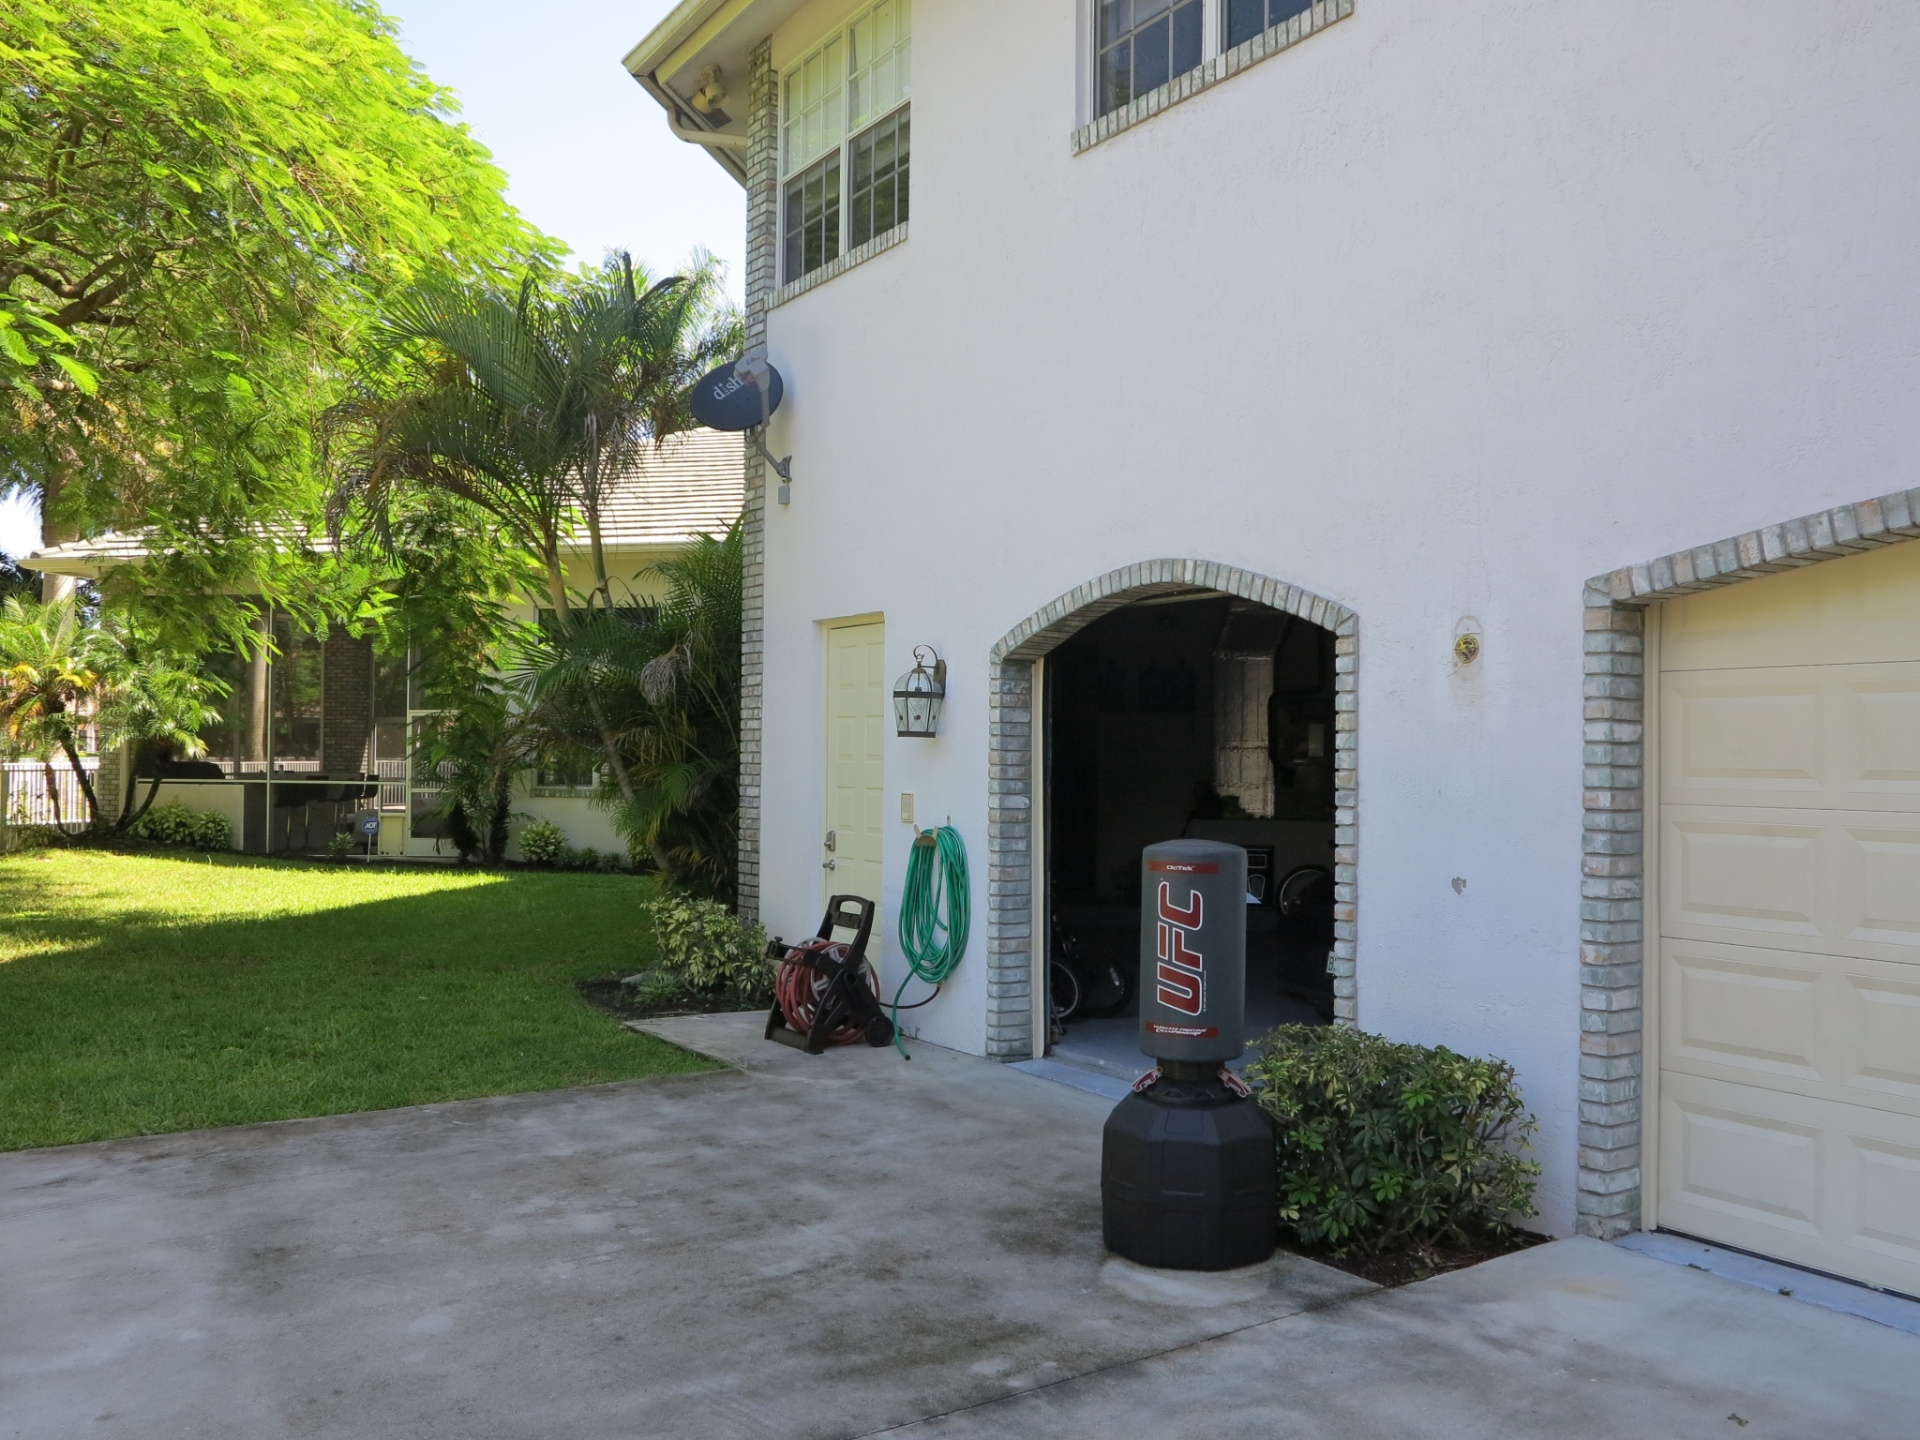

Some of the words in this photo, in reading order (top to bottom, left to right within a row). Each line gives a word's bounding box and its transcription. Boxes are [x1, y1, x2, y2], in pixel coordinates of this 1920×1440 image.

[713, 376, 744, 400] dish
[365, 821, 377, 829] ADT
[1157, 881, 1203, 1016] UFC
